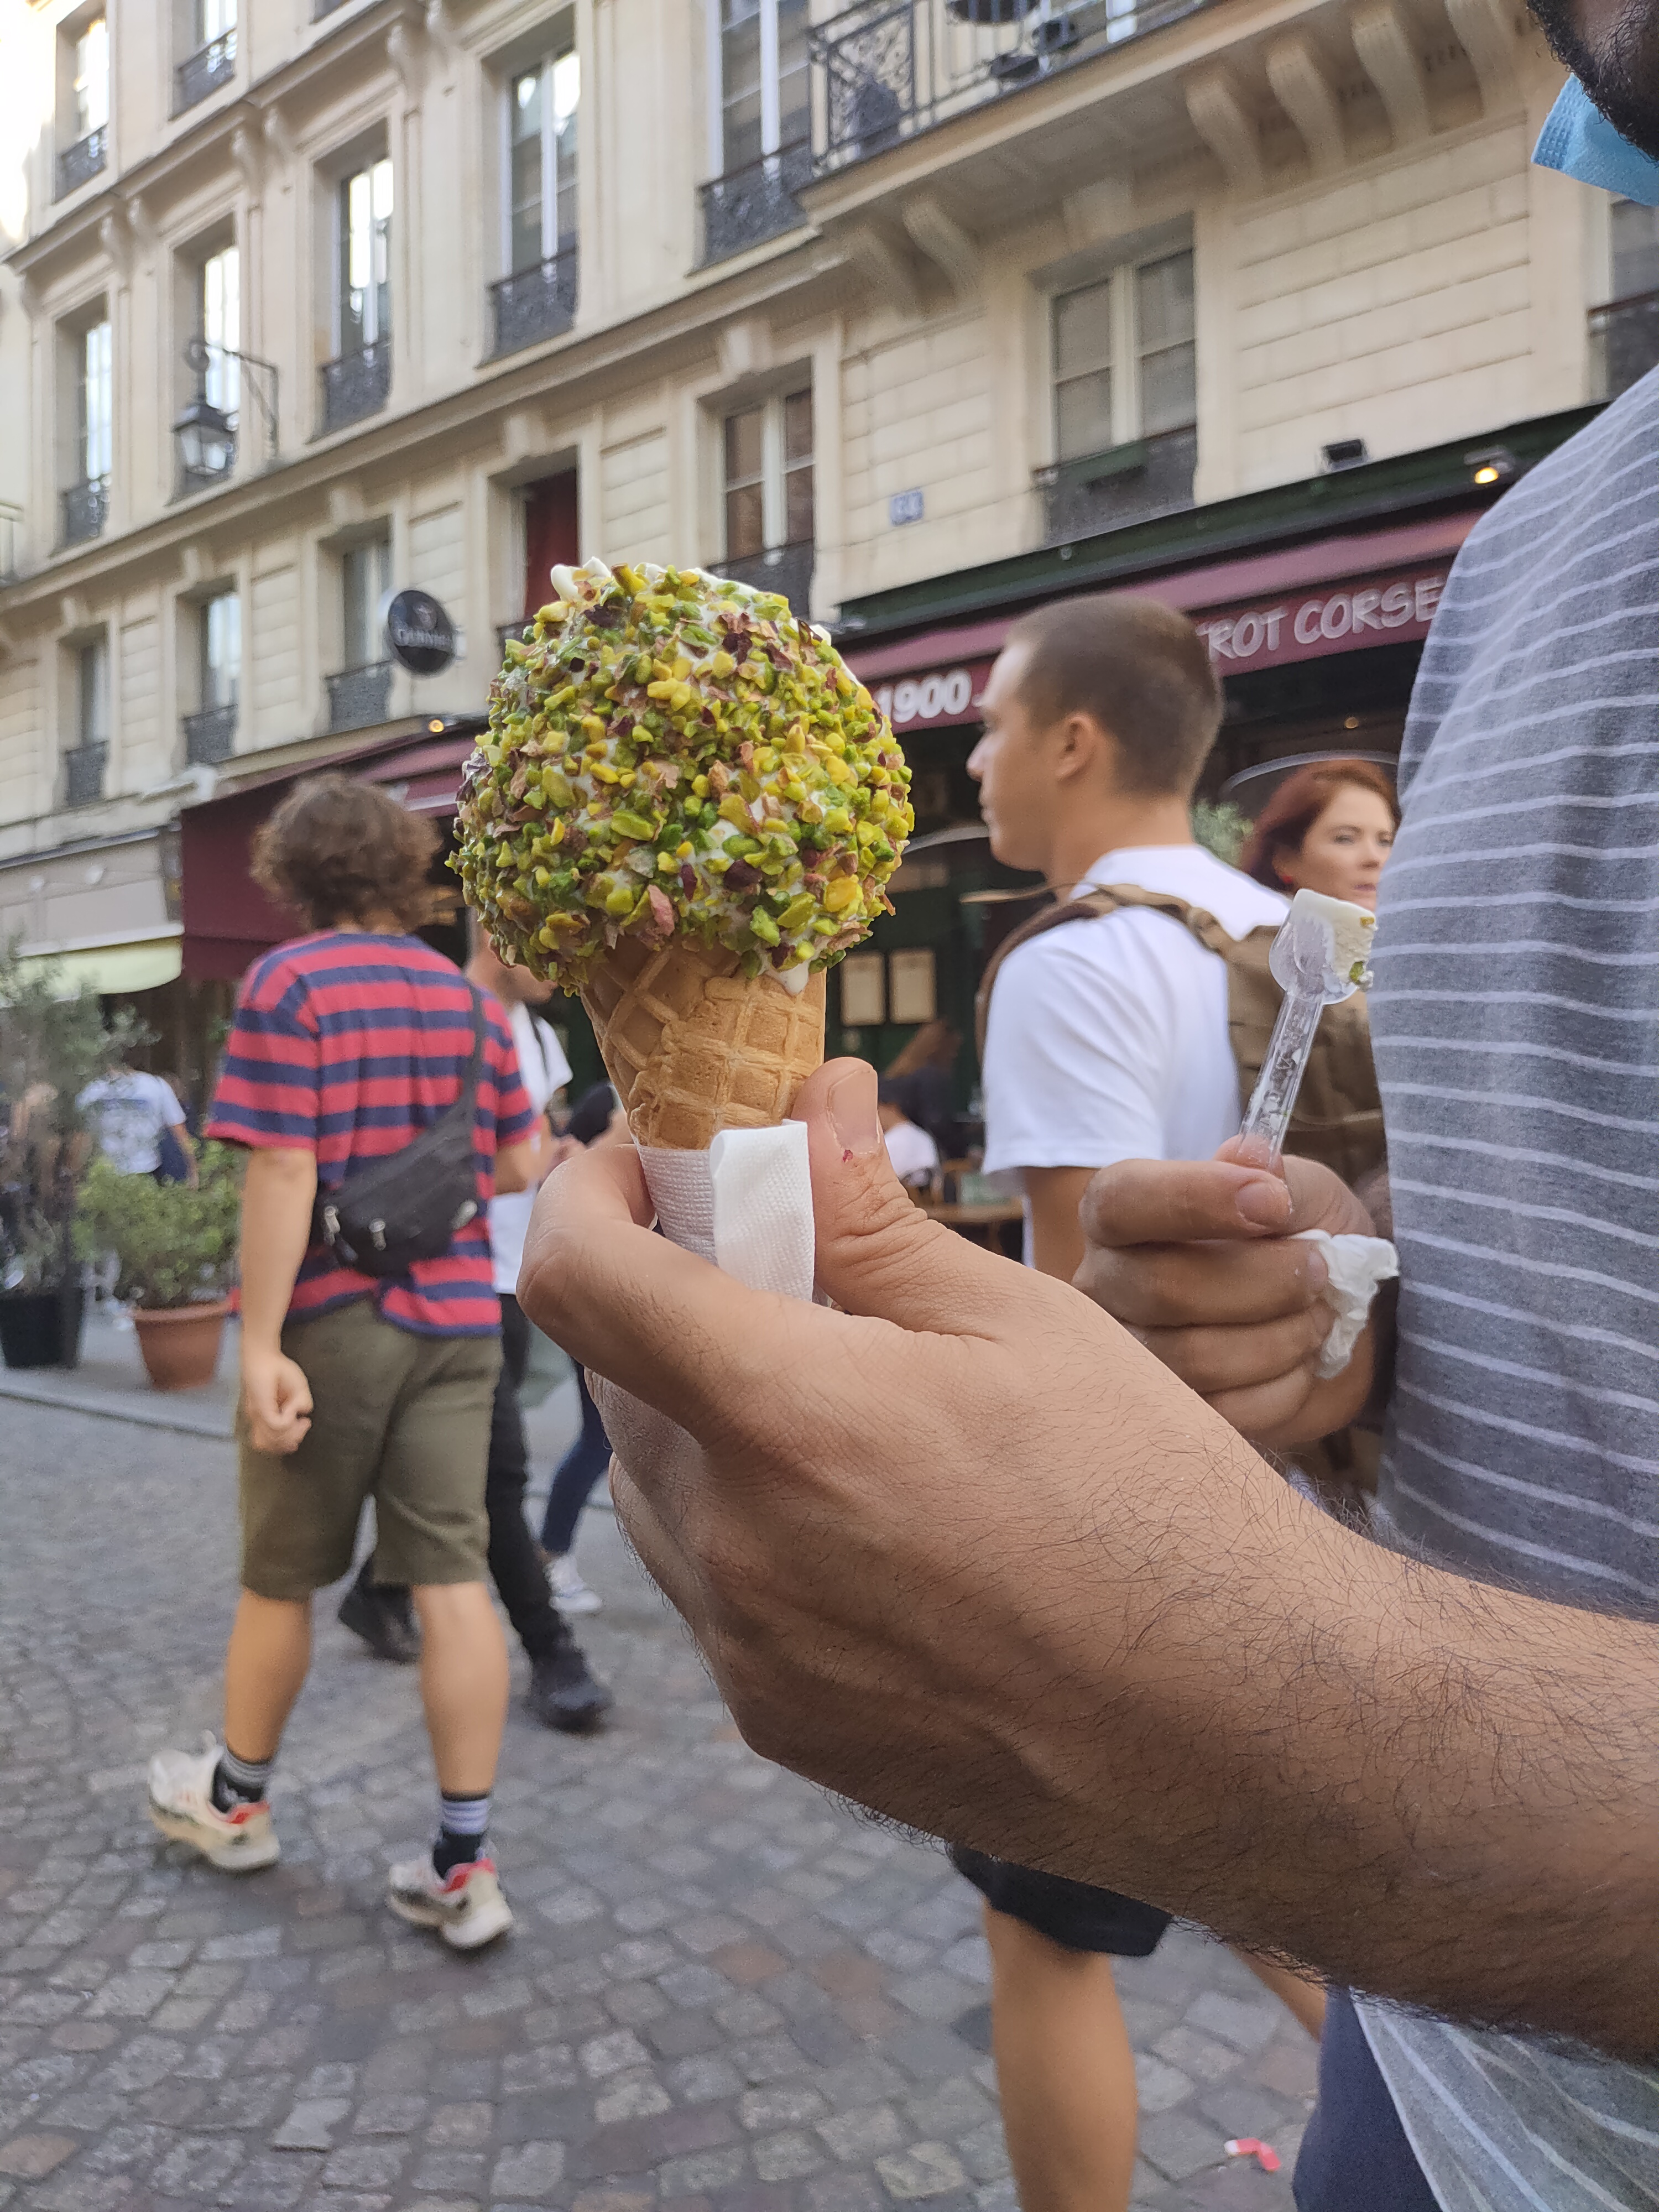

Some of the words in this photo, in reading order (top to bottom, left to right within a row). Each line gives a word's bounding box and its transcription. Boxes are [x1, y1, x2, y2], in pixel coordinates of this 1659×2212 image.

[874, 667, 972, 723] 1900
[1196, 607, 1288, 662] ROT
[1293, 575, 1447, 645] CORSE
